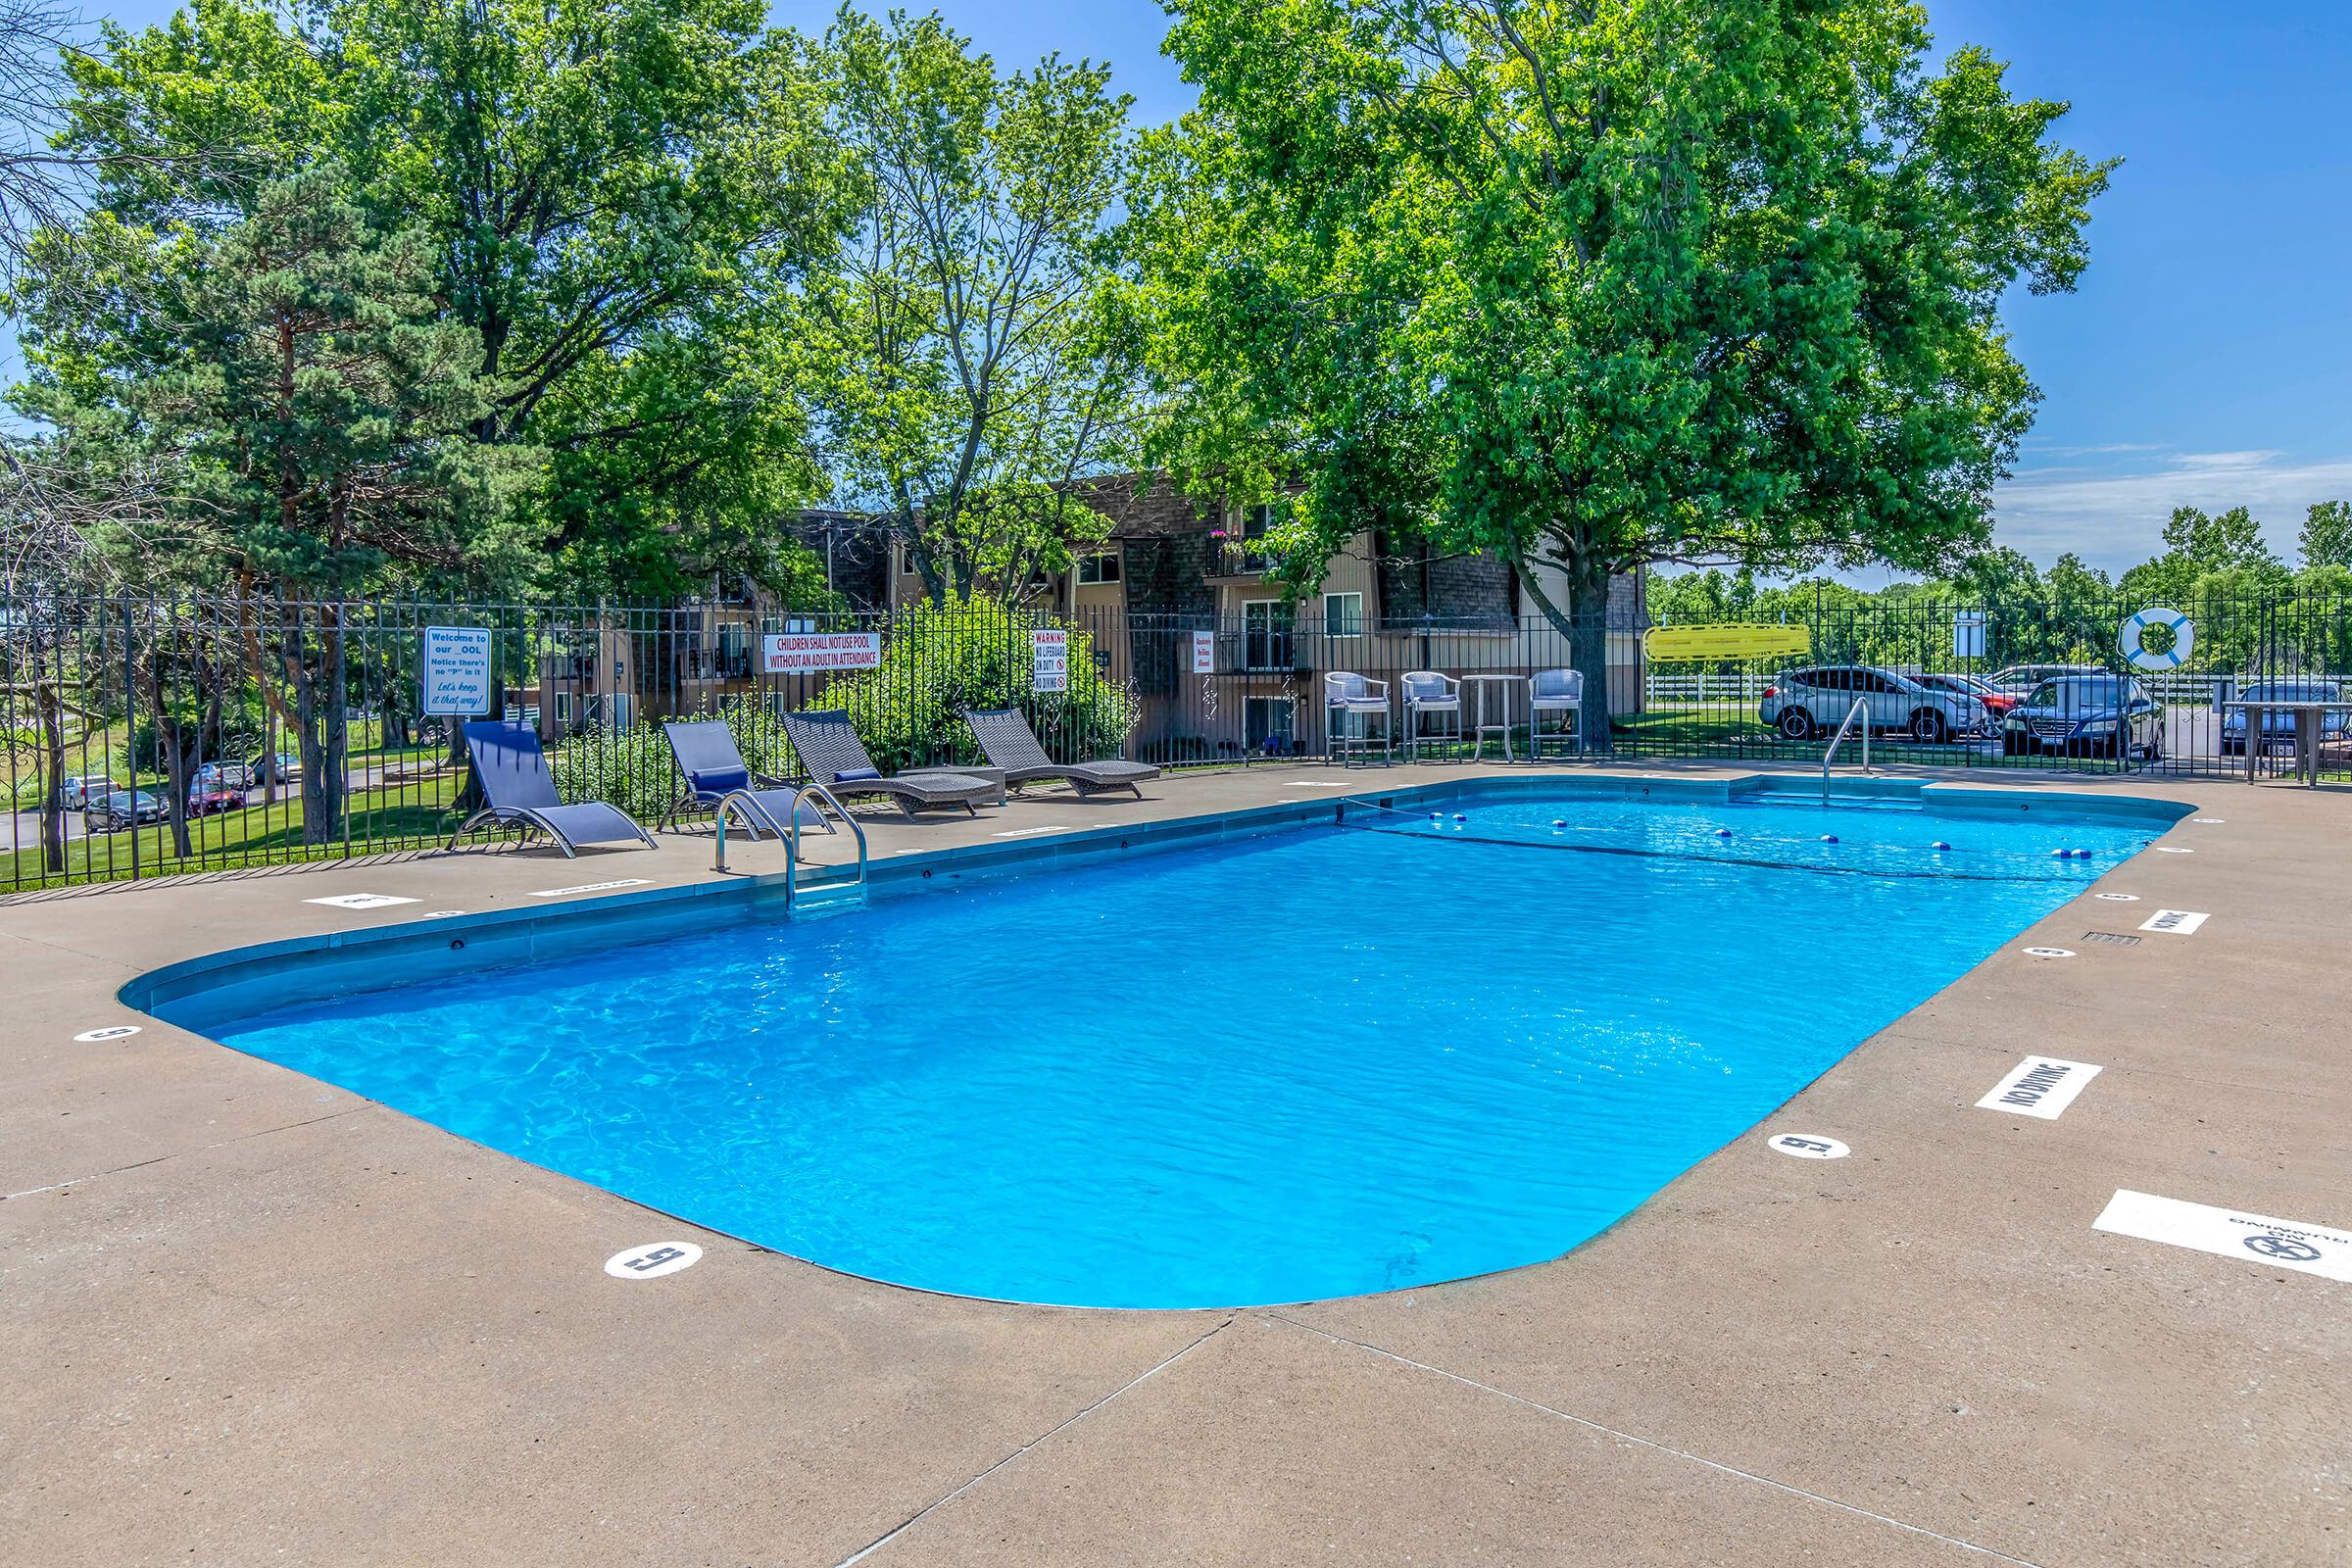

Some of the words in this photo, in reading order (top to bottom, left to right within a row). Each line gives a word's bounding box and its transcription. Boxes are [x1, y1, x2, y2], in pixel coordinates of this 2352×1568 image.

[431, 633, 473, 642] Welcome
[476, 634, 486, 643] to
[777, 637, 809, 651] CHILDREN
[809, 636, 828, 650] SHALL
[828, 636, 843, 649] NOT
[843, 636, 853, 649] USE
[854, 635, 869, 648] POOL
[1035, 632, 1065, 644] WARNING
[1036, 646, 1042, 657] NO
[1043, 646, 1065, 657] LIFEGUARD
[769, 655, 801, 668] WITHOUT
[802, 655, 811, 666] AN
[811, 654, 831, 666] ADULT
[831, 653, 839, 665] IN
[839, 652, 876, 665] ATTENDANCE
[1036, 660, 1042, 670] ON
[1043, 660, 1054, 670] DUTY
[437, 681, 456, 691] Let's
[458, 681, 478, 694] keep
[1036, 677, 1042, 688] NO
[1043, 677, 1056, 688] DIVING
[431, 695, 440, 704] it
[440, 694, 459, 705] that
[460, 694, 483, 709] way!
[2012, 1063, 2072, 1093] DIVING
[1998, 1090, 2042, 1107] NO
